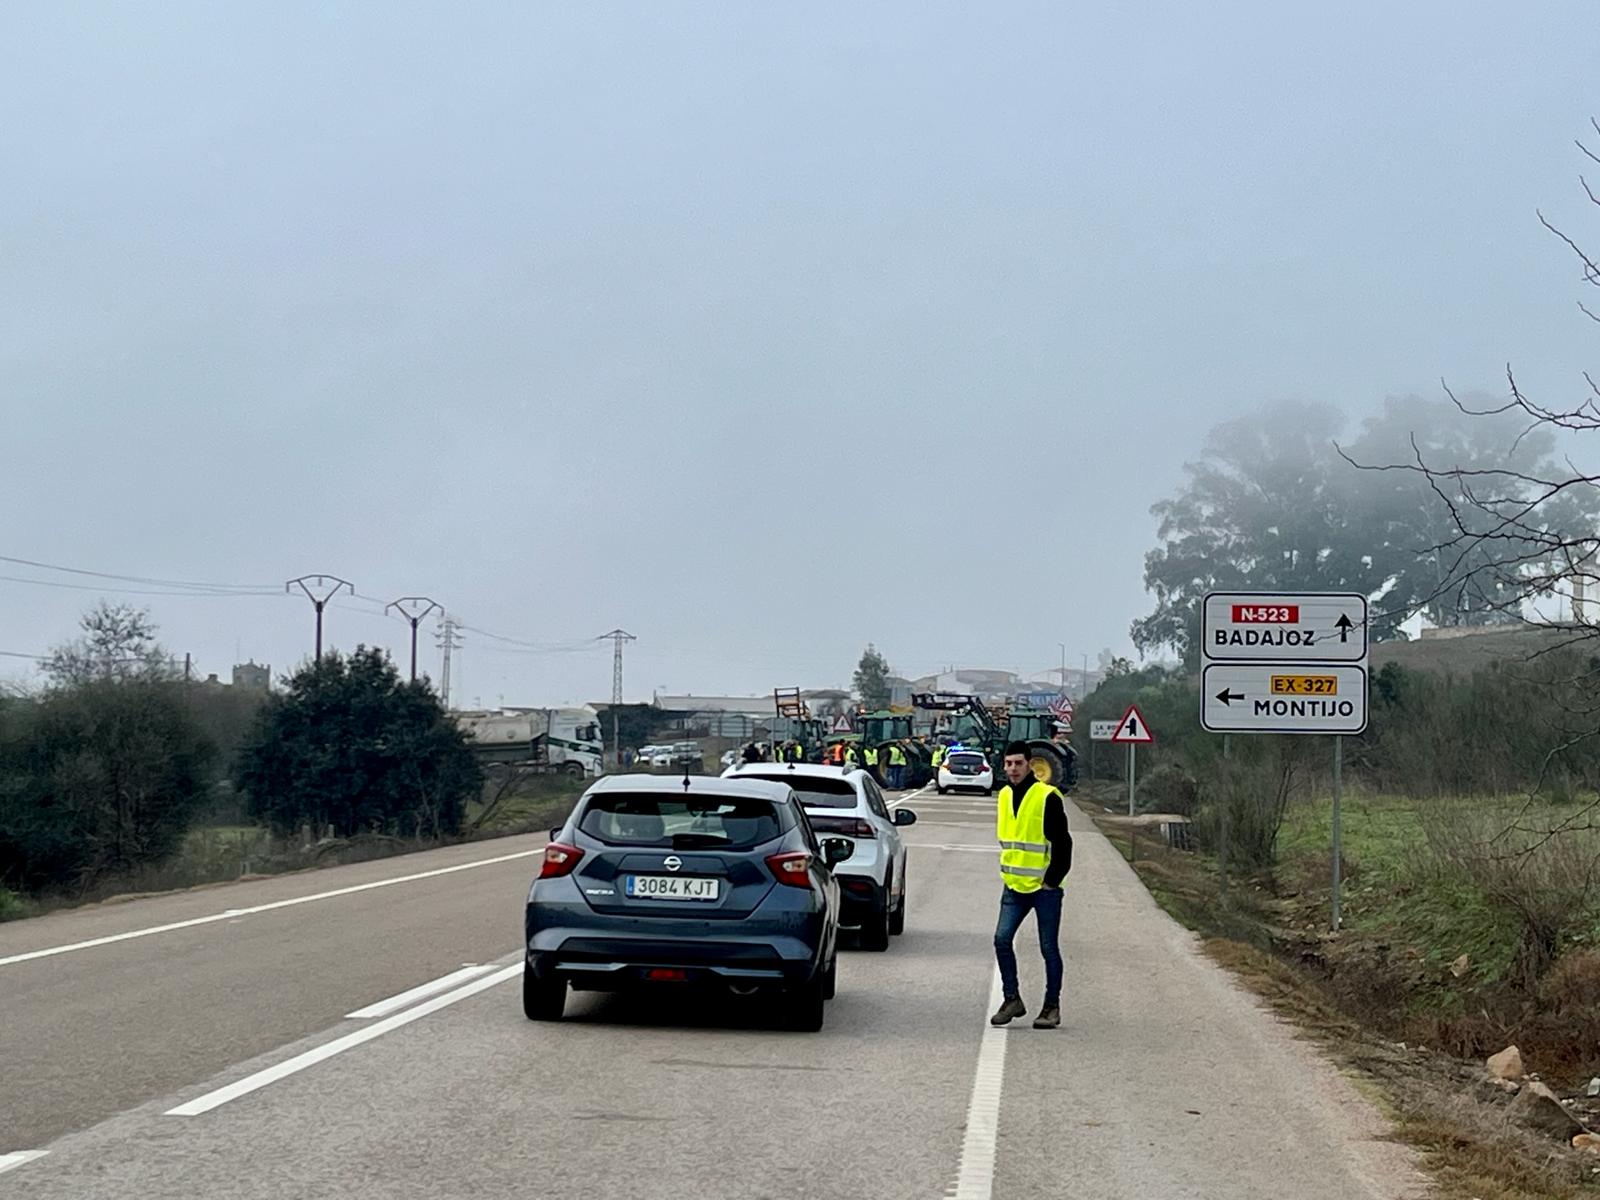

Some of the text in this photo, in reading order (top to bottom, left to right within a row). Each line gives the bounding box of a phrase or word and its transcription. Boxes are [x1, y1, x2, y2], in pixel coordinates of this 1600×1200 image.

[1241, 608, 1289, 621] N-523
[1215, 630, 1315, 646] BADAJOZ
[1274, 679, 1334, 692] EX-327
[1254, 700, 1353, 717] MONTIJO
[638, 878, 714, 896] 3084 KJT
